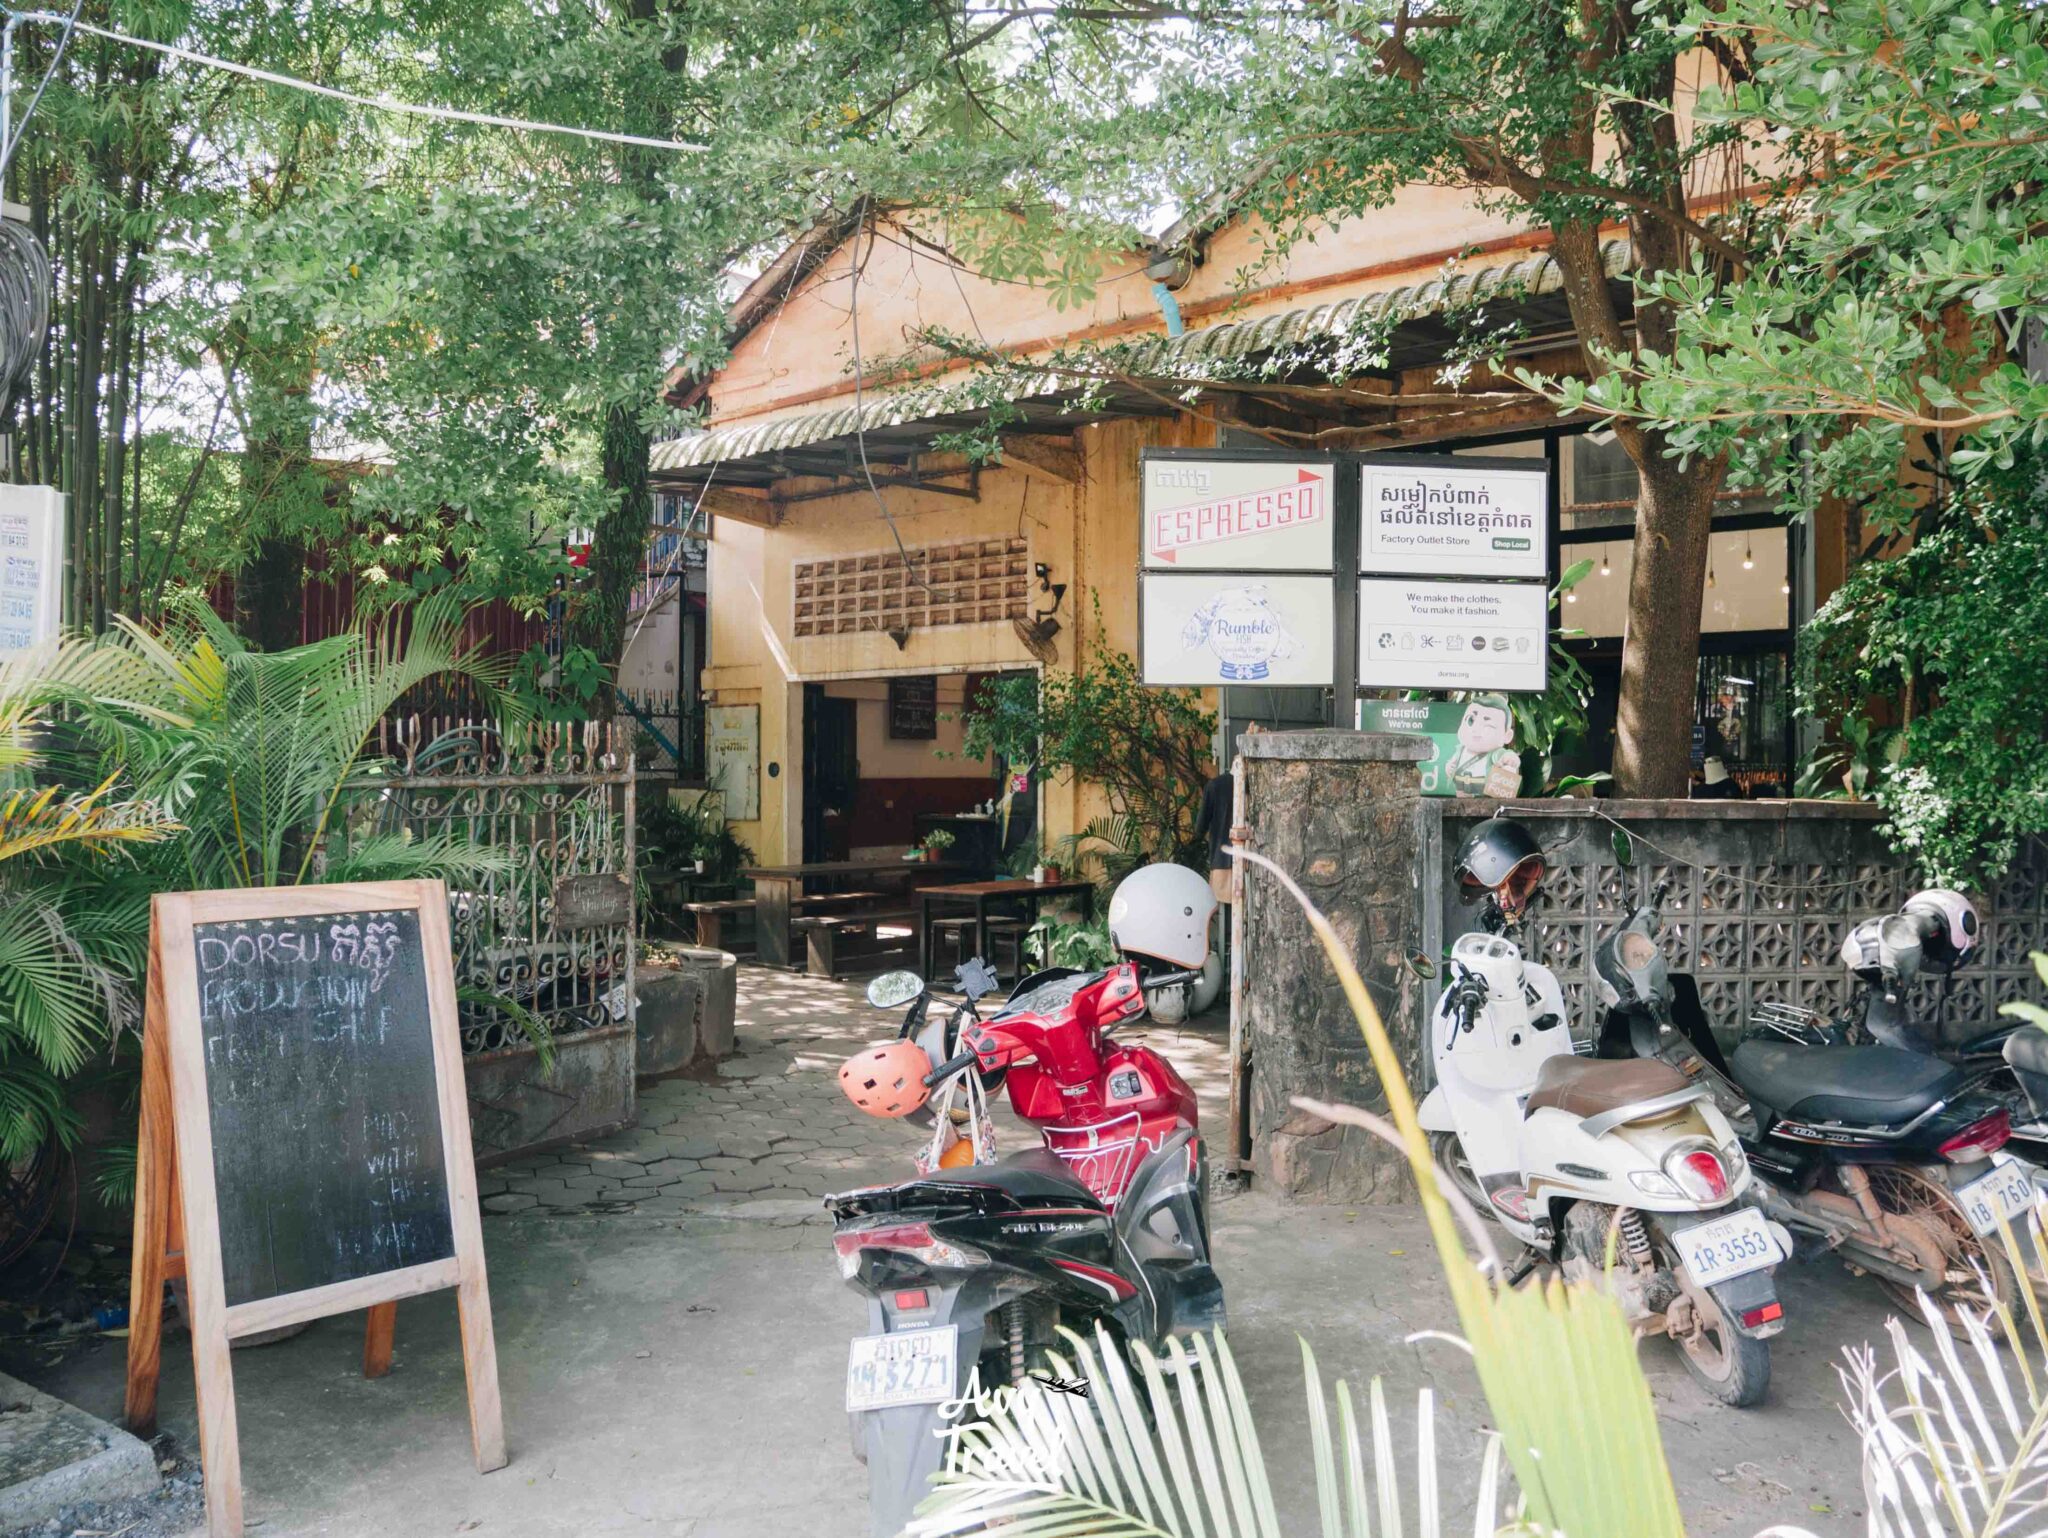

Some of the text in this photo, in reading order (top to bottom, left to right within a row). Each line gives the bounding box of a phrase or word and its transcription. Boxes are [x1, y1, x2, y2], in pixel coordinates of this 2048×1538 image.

[1157, 487, 1313, 547] ESPRESSO
[1381, 534, 1470, 546] Factory Outlet Store
[1494, 540, 1529, 549] Shop Local
[1406, 593, 1502, 604] We make the clothes.
[1411, 605, 1500, 616] You make it fashion.
[1214, 618, 1274, 637] Rumble
[1388, 719, 1423, 729] We're on
[199, 932, 321, 973] DORSU
[897, 1320, 930, 1330] HONDA
